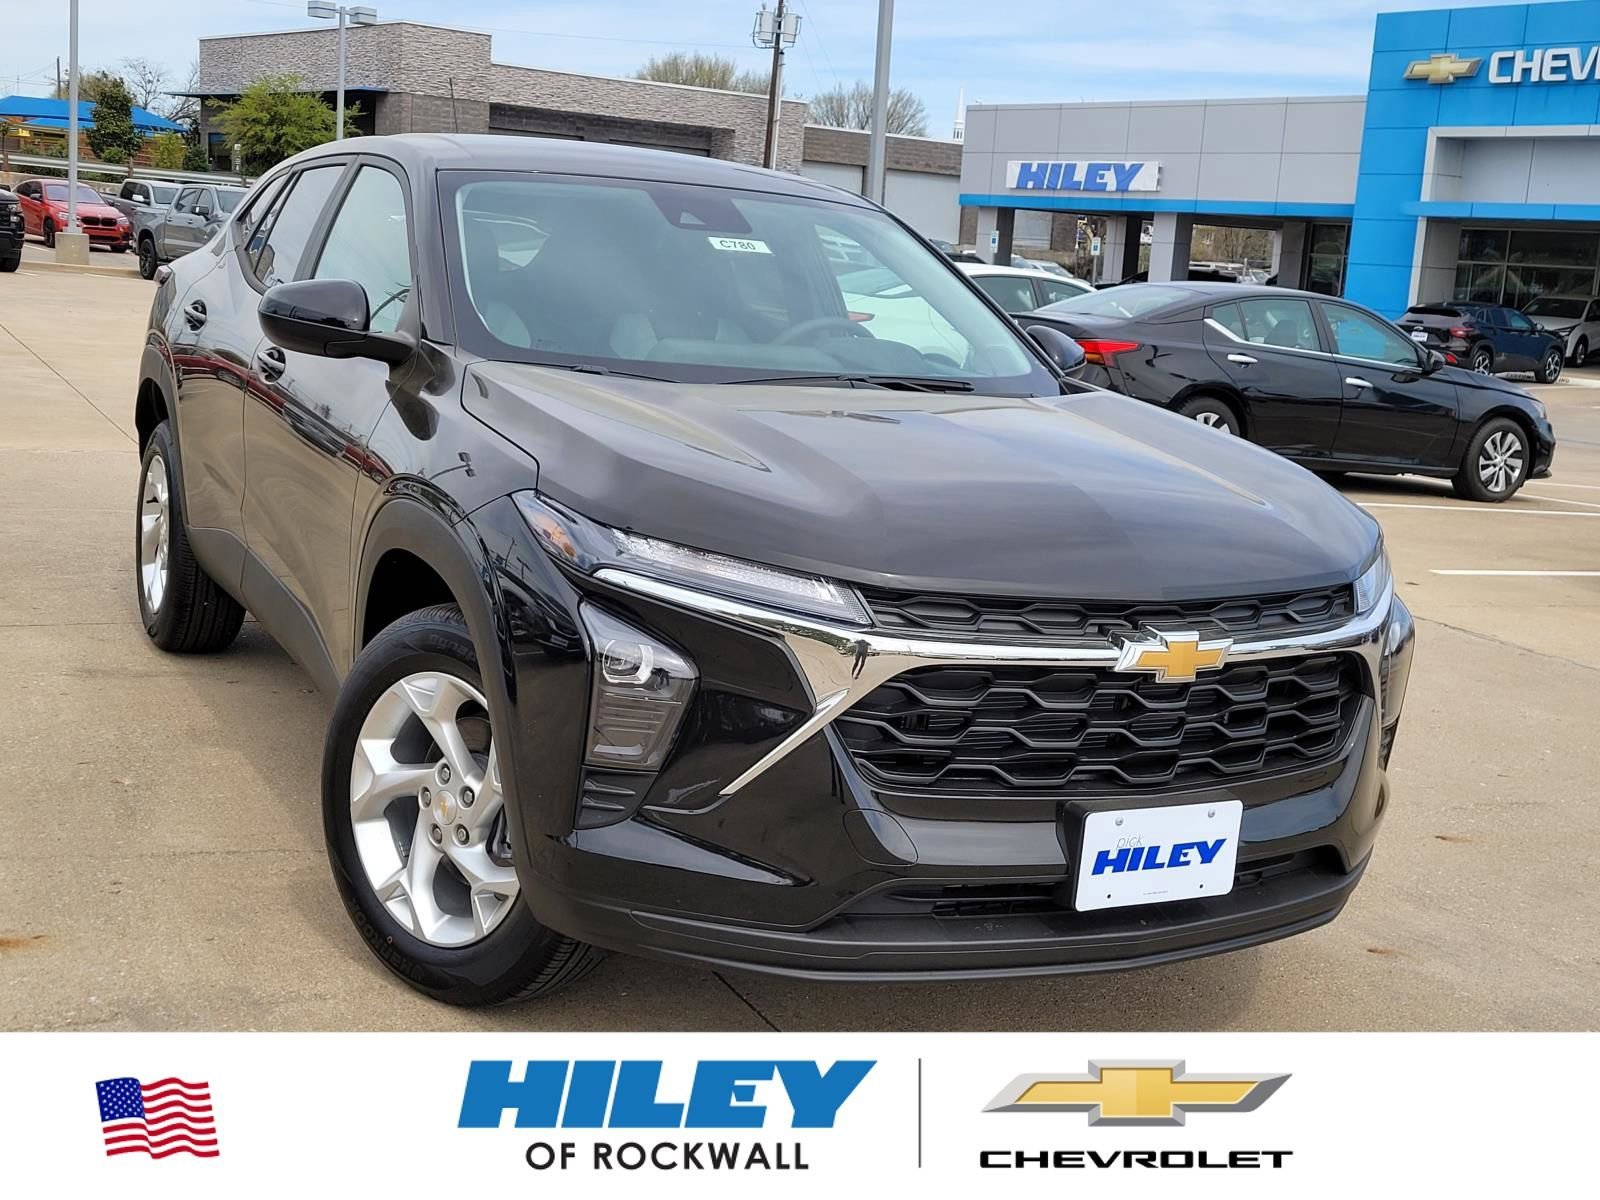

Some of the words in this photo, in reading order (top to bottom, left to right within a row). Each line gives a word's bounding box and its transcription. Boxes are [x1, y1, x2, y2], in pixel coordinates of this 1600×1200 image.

[1015, 162, 1145, 192] HILEY
[719, 239, 757, 251] C780
[1115, 834, 1144, 851] pick
[1091, 838, 1228, 876] HILEY
